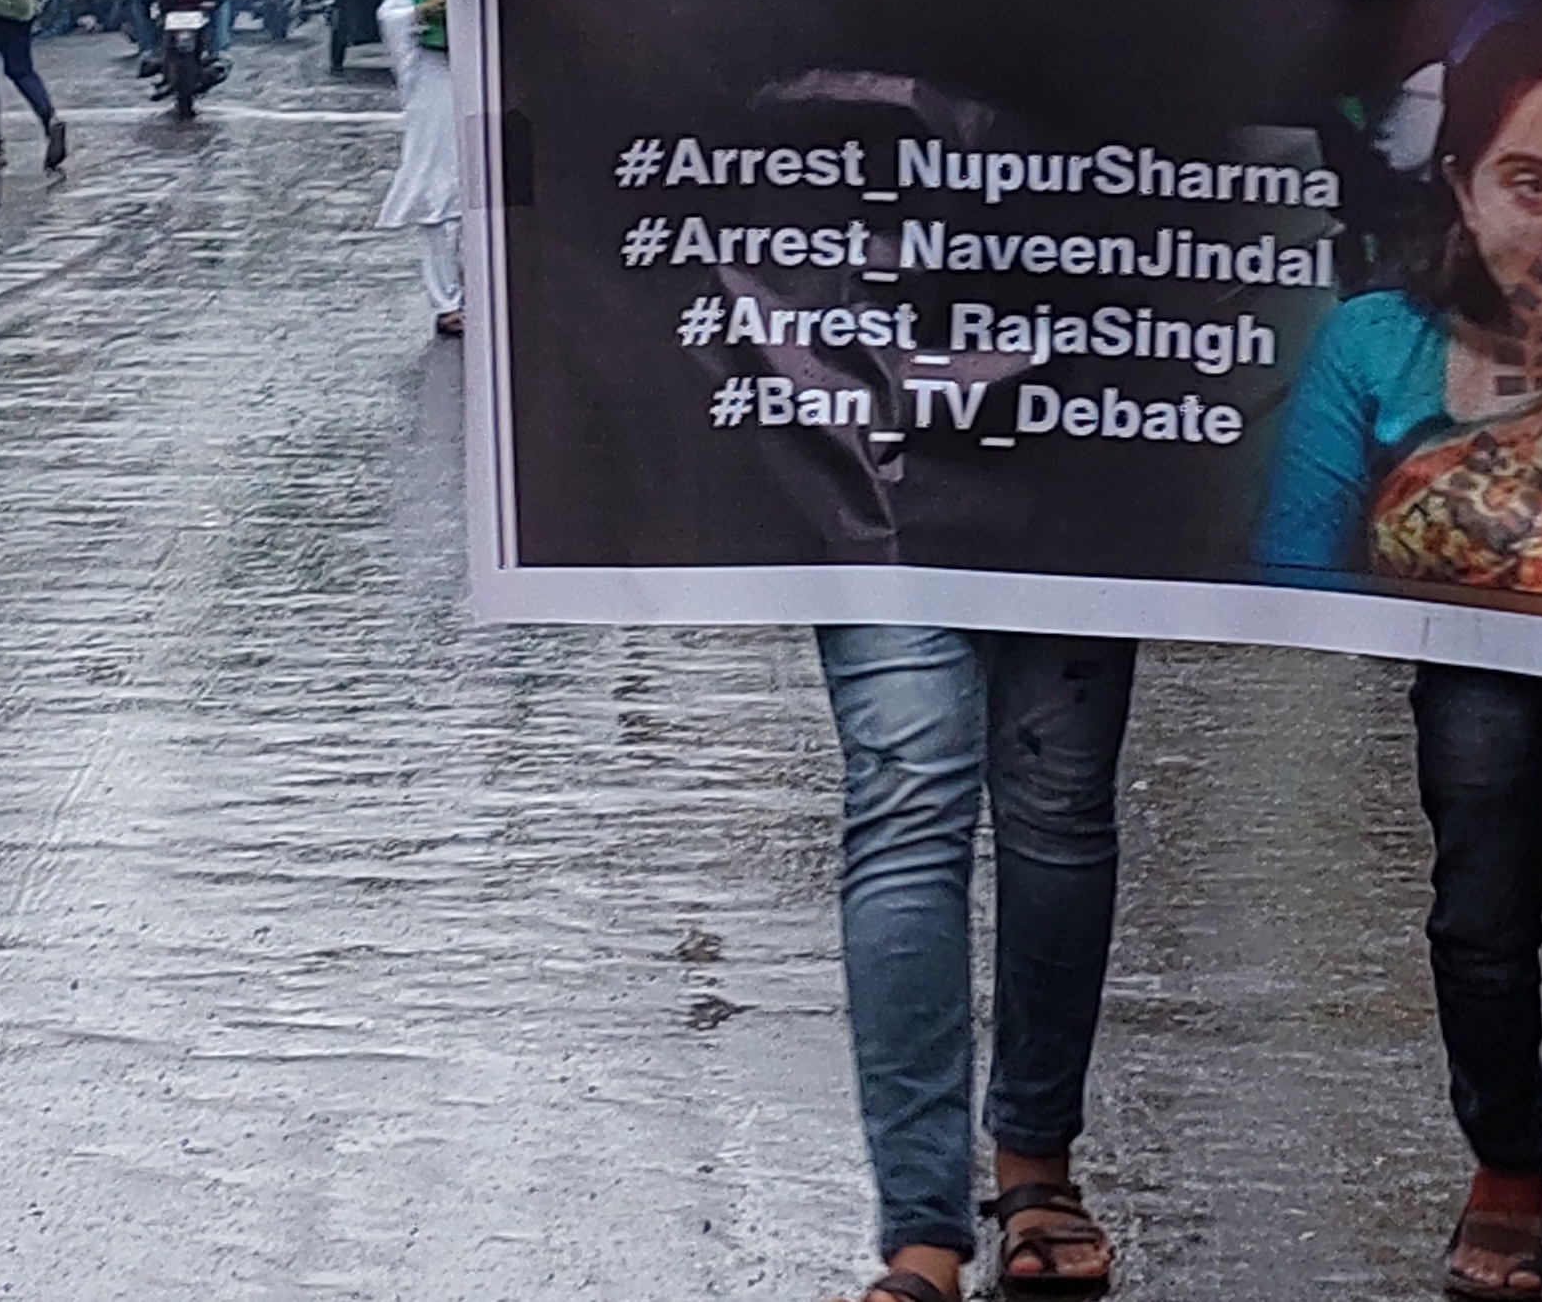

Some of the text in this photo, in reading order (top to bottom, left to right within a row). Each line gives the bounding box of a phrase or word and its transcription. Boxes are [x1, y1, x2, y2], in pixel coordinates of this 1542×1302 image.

[614, 137, 1341, 208] #Arrest_NupurSharma
[621, 216, 1335, 288] #Arrest_NaveenJindal
[676, 296, 1276, 375] #Arrest_RajaSingh
[709, 376, 1243, 447] #Ban_TV_Debate
